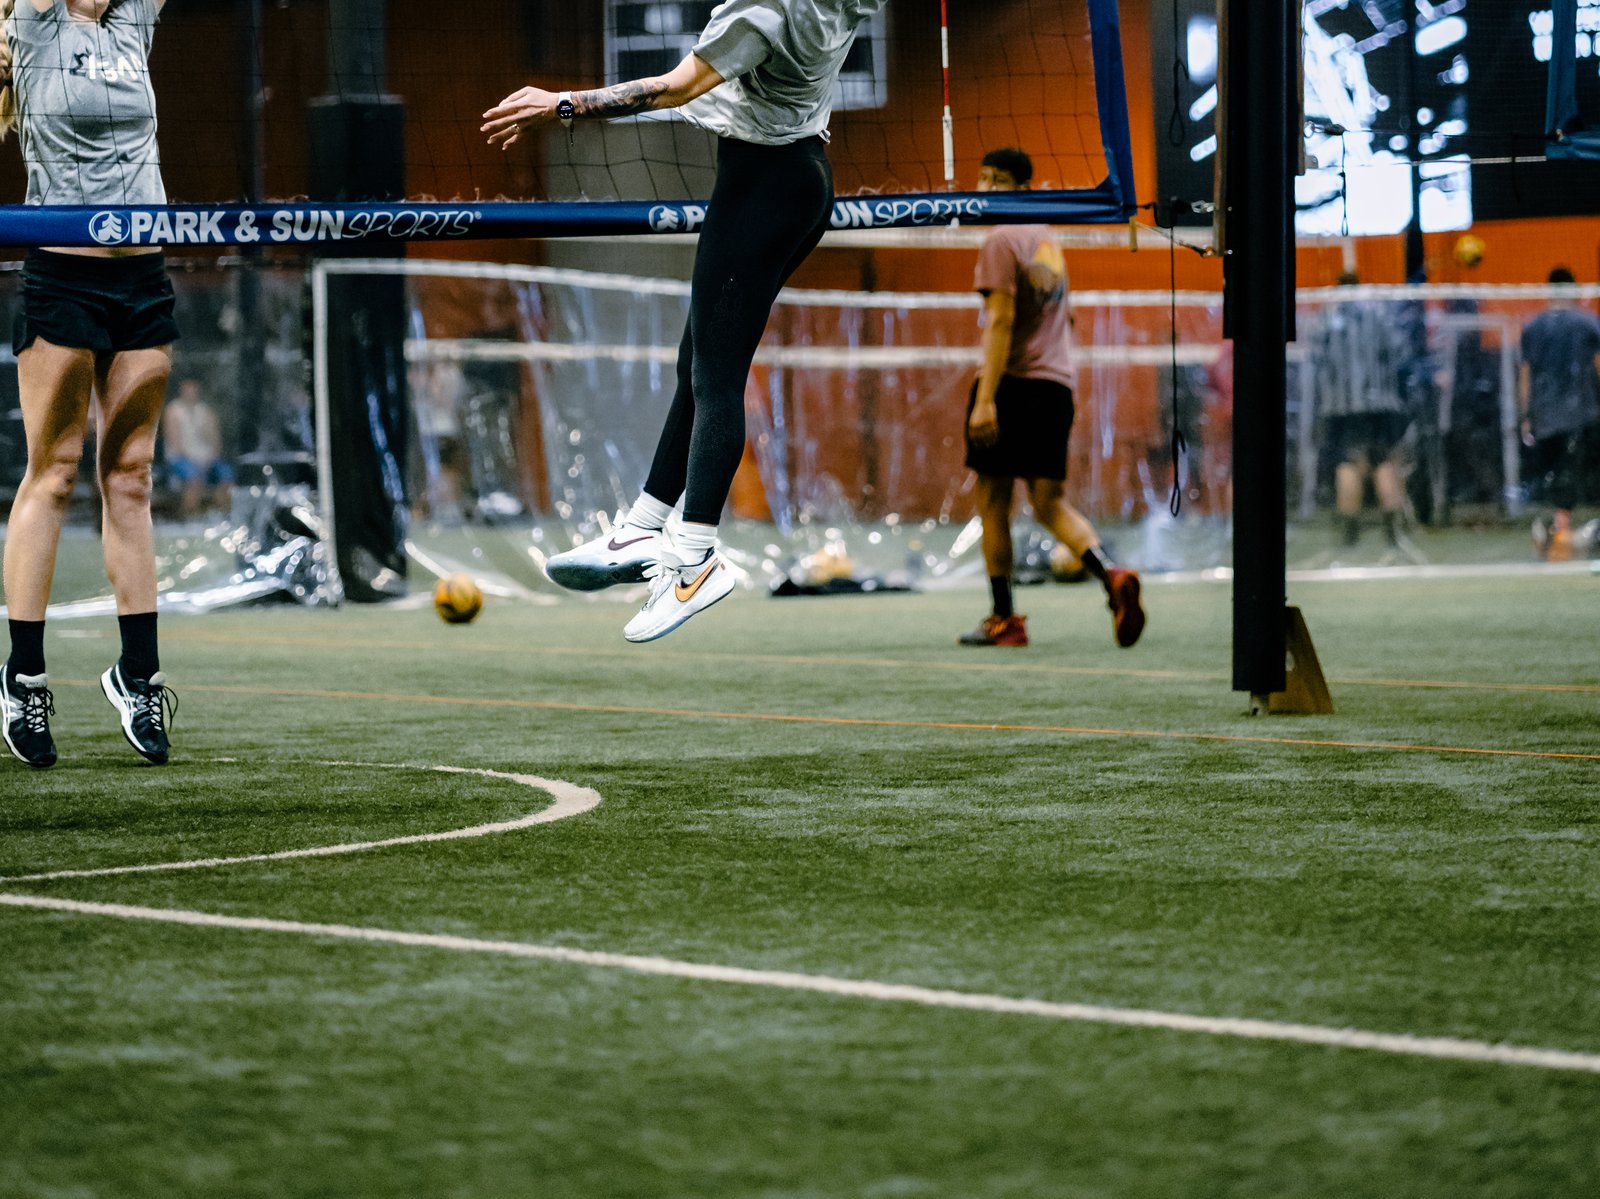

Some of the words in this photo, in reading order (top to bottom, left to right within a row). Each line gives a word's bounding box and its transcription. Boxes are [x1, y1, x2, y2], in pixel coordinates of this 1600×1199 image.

[130, 210, 226, 244] PARK
[234, 210, 260, 242] &
[829, 200, 873, 228] UN
